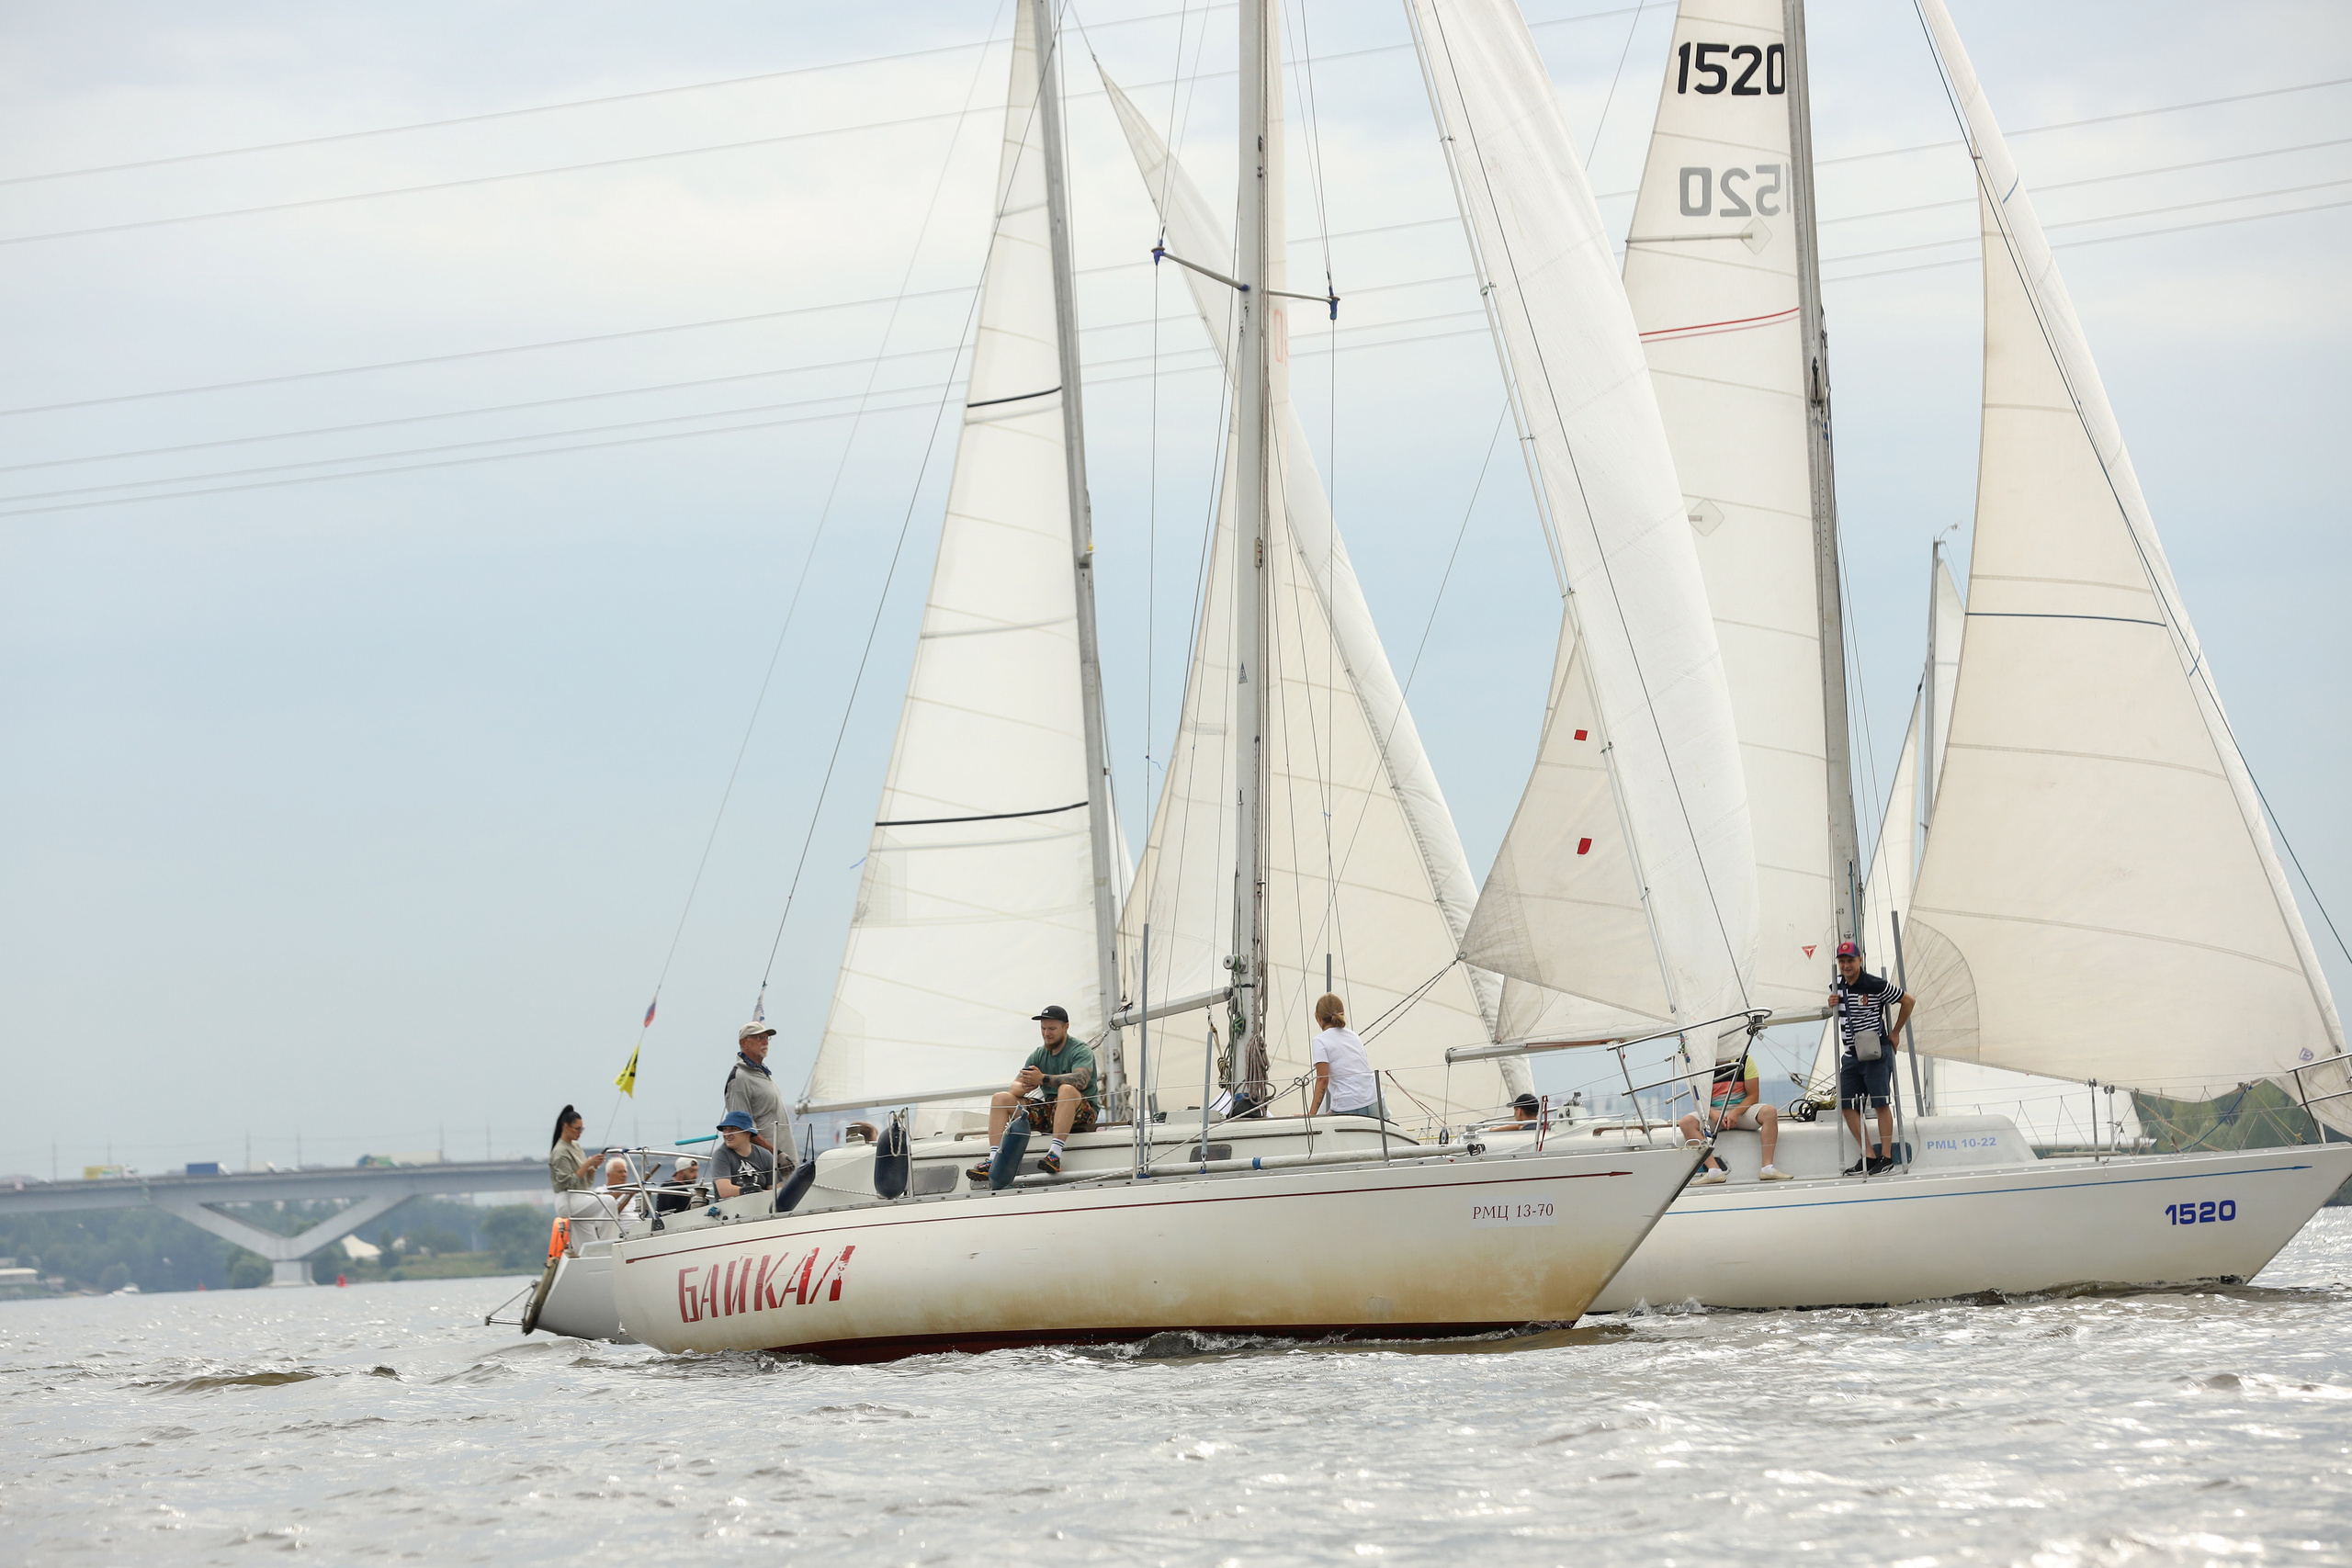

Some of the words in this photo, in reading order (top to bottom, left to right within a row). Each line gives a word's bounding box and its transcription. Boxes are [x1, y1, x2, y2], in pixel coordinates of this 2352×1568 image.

[1678, 41, 1785, 96] 1520
[1927, 1140, 1957, 1150] РМЦ
[1962, 1137, 1996, 1148] 10-22
[1472, 1204, 1509, 1221] РМЦ
[1516, 1202, 1554, 1218] 13-70
[2165, 1200, 2236, 1225] 1520
